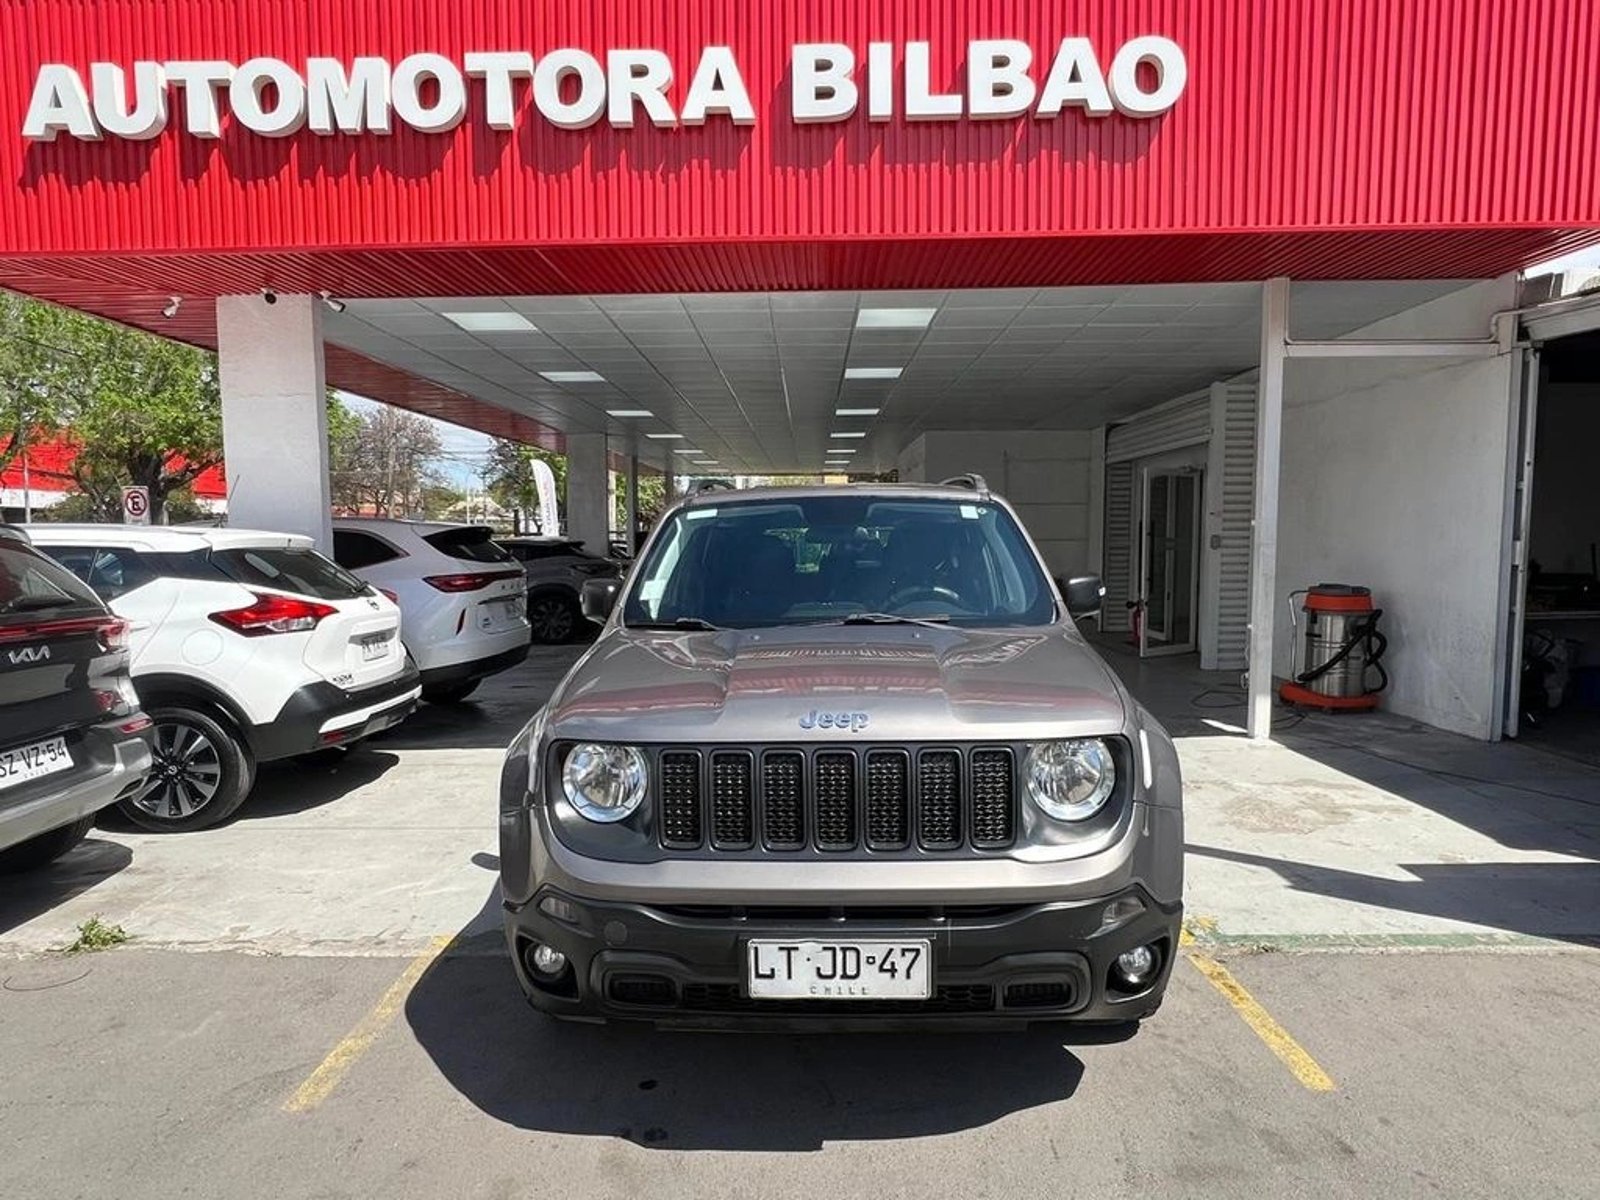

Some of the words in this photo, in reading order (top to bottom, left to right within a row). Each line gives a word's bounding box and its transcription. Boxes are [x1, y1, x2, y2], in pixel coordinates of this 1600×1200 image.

[22, 44, 755, 142] AUTOMOTORA
[791, 36, 1188, 124] BILBAO
[799, 710, 869, 733] Jeep
[810, 986, 868, 996] CHILE
